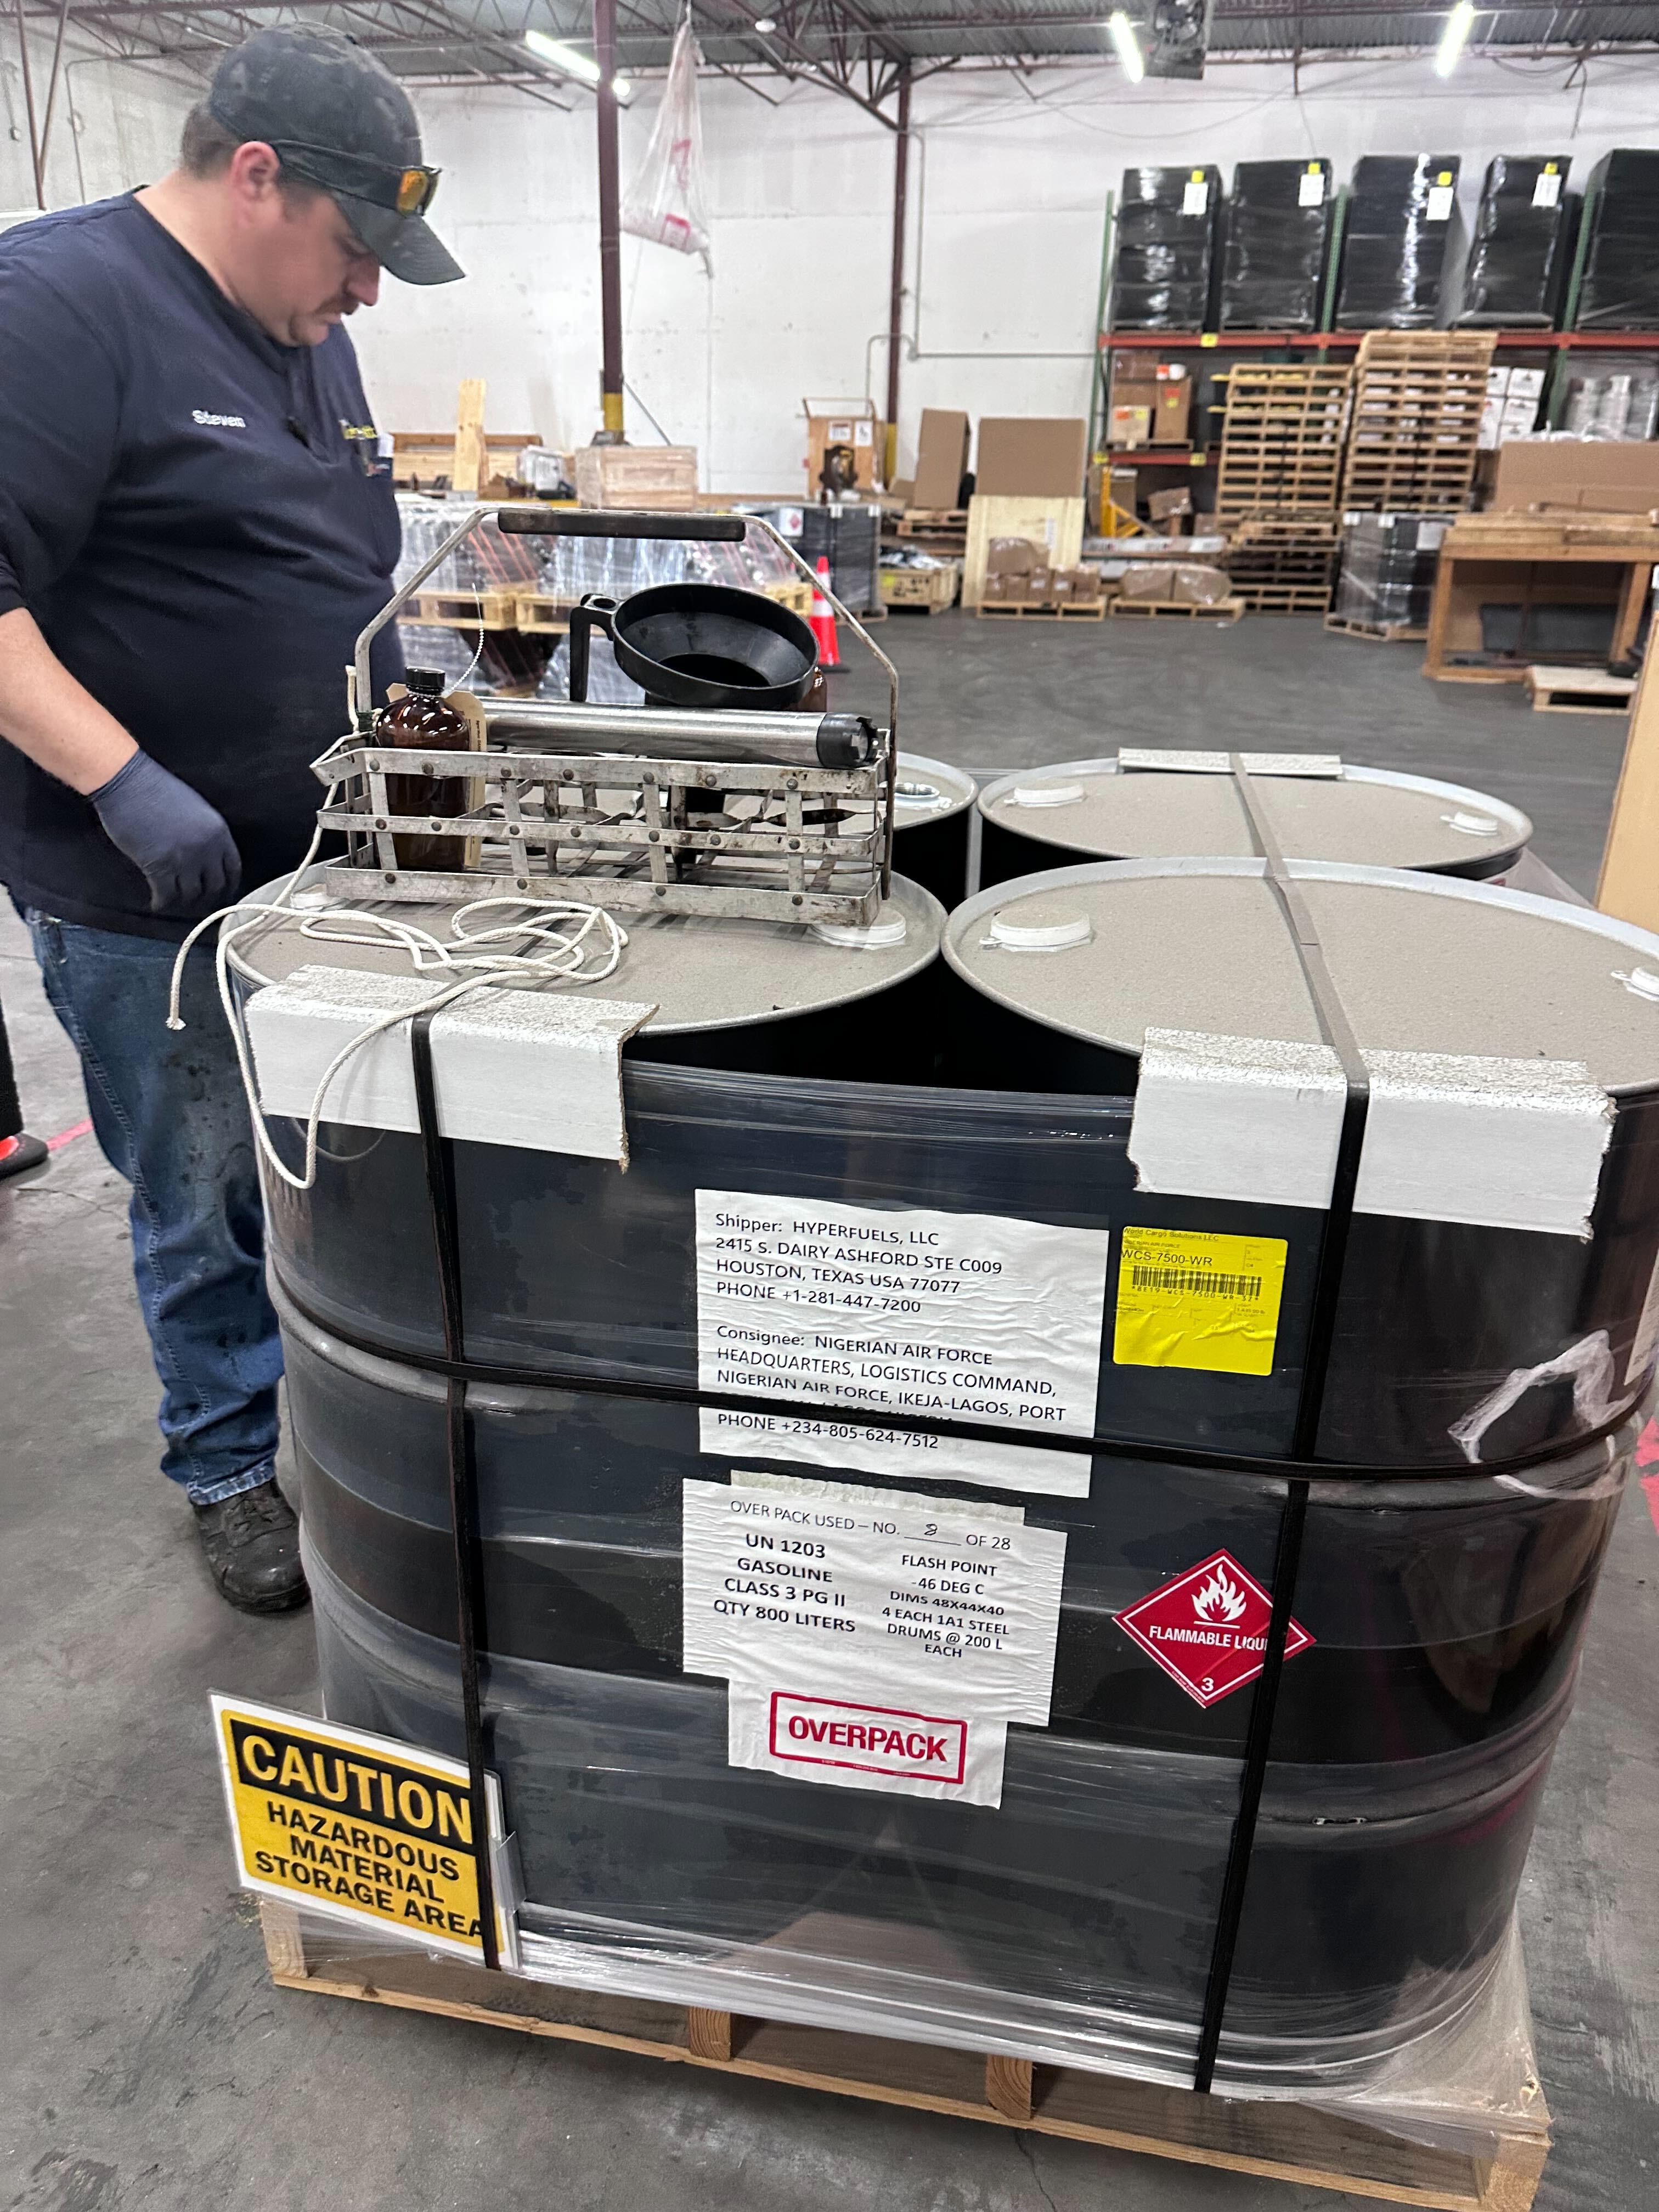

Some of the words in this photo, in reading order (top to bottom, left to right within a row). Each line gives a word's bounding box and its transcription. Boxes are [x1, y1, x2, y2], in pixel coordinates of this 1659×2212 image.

[716, 1214, 782, 1233] Shipper:
[793, 1221, 904, 1245] HYPERFUELS,
[910, 1231, 939, 1246] LLC
[1169, 1232, 1202, 1240] Solutions
[716, 1237, 752, 1252] 2415
[758, 1242, 771, 1254] S.
[778, 1242, 830, 1259] DAIRY
[834, 1248, 918, 1266] ASHFORD
[924, 1256, 953, 1270] STE
[960, 1259, 1002, 1274] C009
[1121, 1249, 1212, 1267] WCS-7500-WR
[717, 1259, 806, 1281] HOUSTON,
[811, 1268, 864, 1285] TEXAS
[870, 1274, 904, 1289] USA
[910, 1278, 960, 1293] 77077
[717, 1282, 776, 1299] PHONE
[783, 1289, 921, 1312] +1-281-447-7200
[717, 1325, 804, 1346] Consignee:
[815, 1335, 897, 1355] NIGERIAN
[902, 1344, 932, 1359] AIR
[938, 1348, 992, 1365] FORCE
[718, 1347, 854, 1378] HEADQUARTERS,
[861, 1363, 947, 1385] LOGISTICS
[952, 1373, 1056, 1397] COMMAND,
[718, 1369, 797, 1390] NIGERIAN
[802, 1381, 830, 1393] AIR
[836, 1385, 892, 1404] FORCE,
[899, 1392, 1013, 1417] IKEJA-LAGOS,
[1019, 1404, 1066, 1421] PORT
[718, 1414, 775, 1430] PHONE
[782, 1421, 938, 1449] +234-805-624-7512
[731, 1500, 769, 1517] OVER
[775, 1508, 810, 1524] PACK
[815, 1515, 855, 1530] USED
[873, 1521, 900, 1535] NO.
[966, 1534, 987, 1547] OF
[991, 1537, 1011, 1550] 28
[746, 1533, 774, 1550] UN
[781, 1540, 825, 1559] 1203
[737, 1558, 833, 1583] GASOLINE
[902, 1554, 946, 1570] FLASH
[951, 1560, 998, 1577] POINT
[725, 1578, 780, 1598] CLASS
[785, 1586, 796, 1600] 3
[803, 1589, 828, 1604] PG
[834, 1593, 845, 1607] II
[912, 1578, 936, 1590] -46
[940, 1579, 970, 1594] DEG
[975, 1584, 984, 1595] C
[714, 1599, 750, 1616] QTY
[755, 1606, 789, 1623] 800
[795, 1612, 856, 1632] LITERS
[890, 1590, 928, 1605] DIMS
[932, 1598, 1005, 1616] 48X44X40
[882, 1607, 891, 1617] 4
[895, 1609, 932, 1623] EACH
[937, 1615, 964, 1628] 1A1
[968, 1620, 1009, 1635] STEEL
[887, 1623, 941, 1641] DRUMS
[946, 1632, 960, 1645] @
[965, 1634, 991, 1649] 200
[996, 1638, 1002, 1650] L
[925, 1644, 962, 1658] EACH
[1149, 1626, 1231, 1647] FLAMMABLE
[1234, 1635, 1268, 1651] LIQUI
[1201, 1677, 1214, 1691] 3
[788, 1715, 948, 1762] OVERPACK
[241, 1735, 472, 1844] CAUTION
[267, 1801, 460, 1881] HAZARDOUS
[290, 1836, 445, 1904] MATERIAL
[255, 1850, 395, 1912] STORAGE
[404, 1899, 483, 1938] AREA
